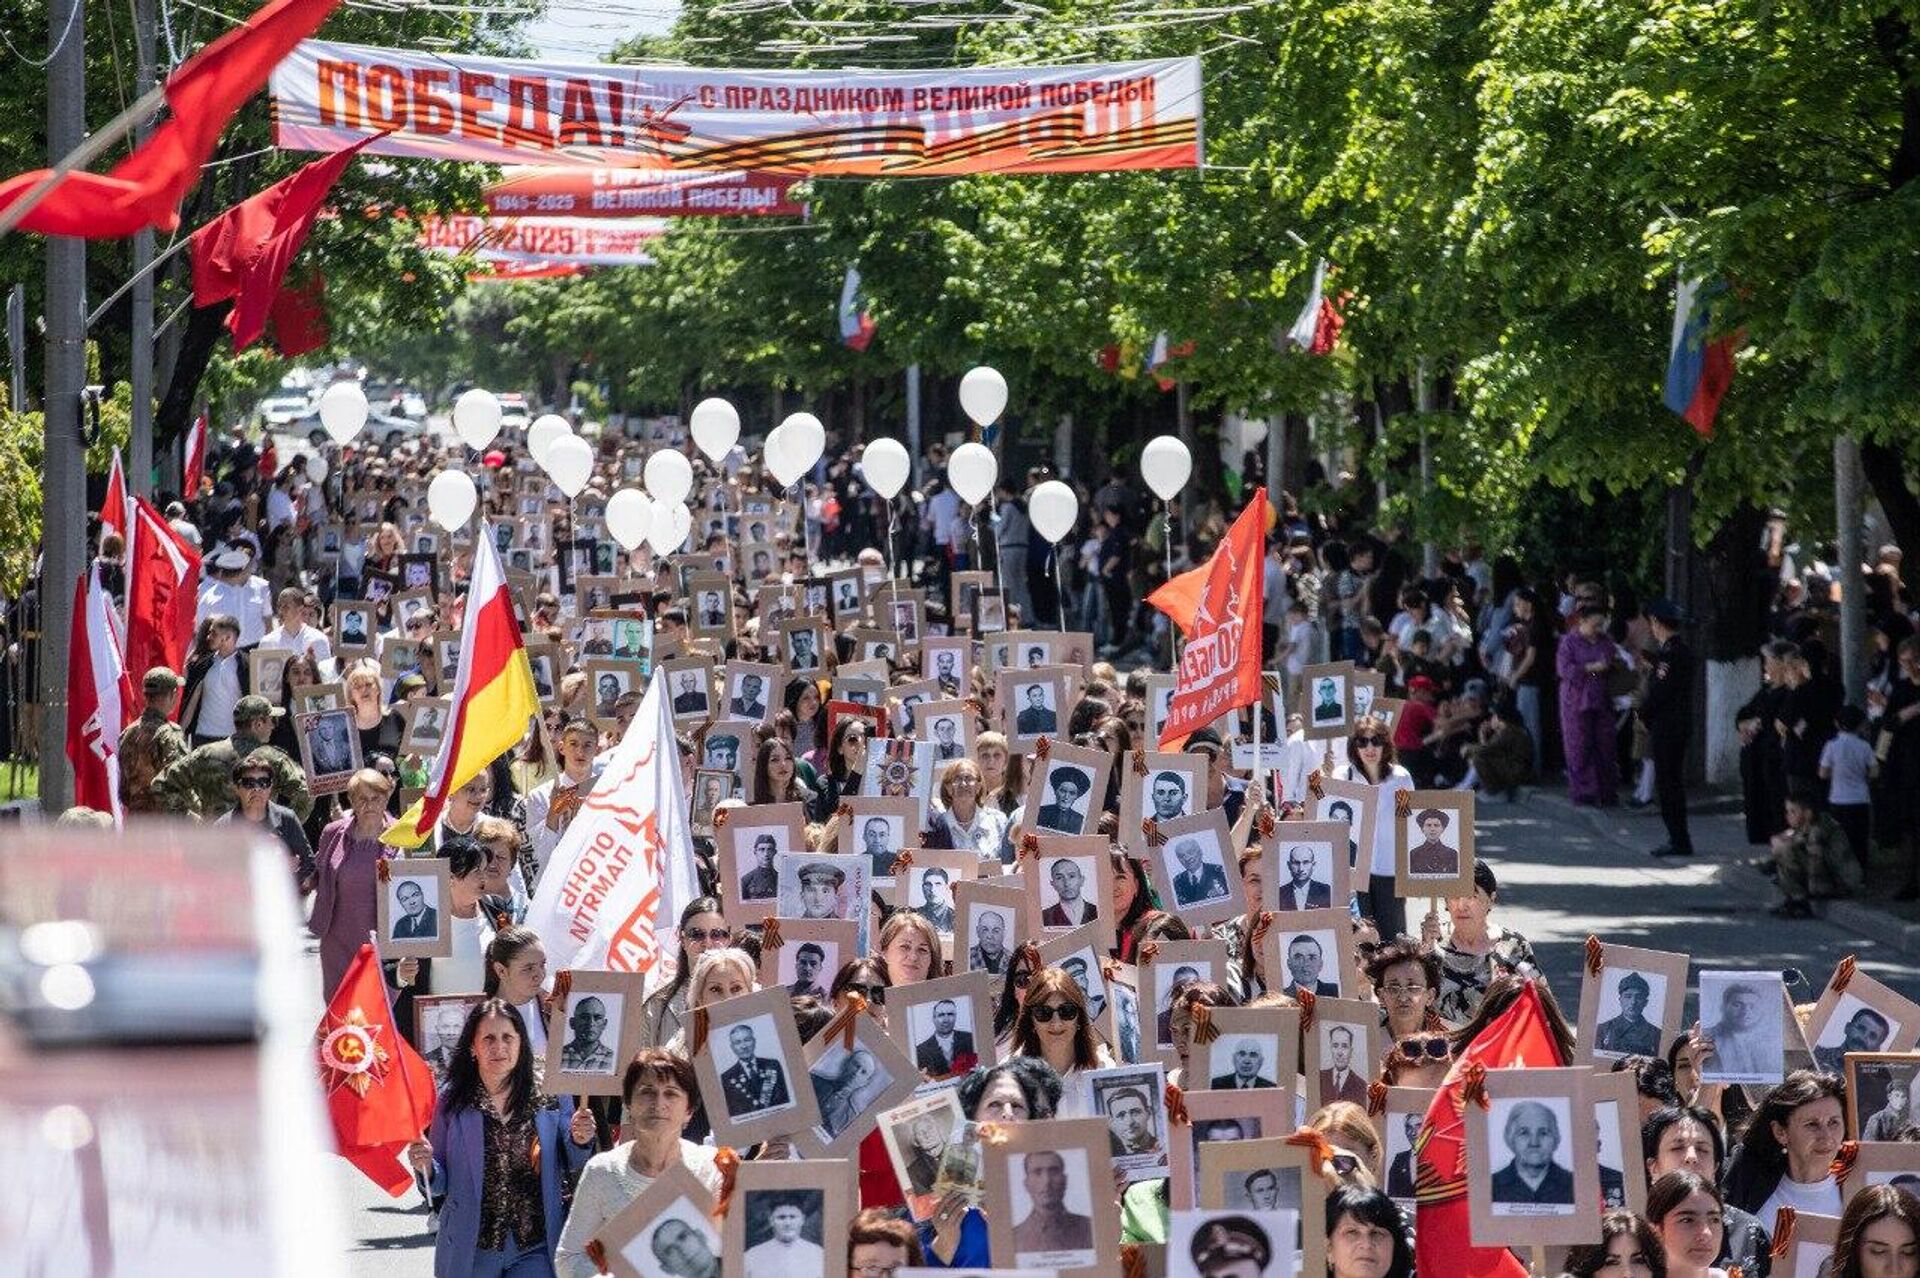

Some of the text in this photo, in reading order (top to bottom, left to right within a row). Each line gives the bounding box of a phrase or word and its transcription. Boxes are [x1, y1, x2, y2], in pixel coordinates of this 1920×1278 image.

[316, 58, 626, 150] ПОБЕДА!
[700, 76, 1156, 115] С ПРАЗДНИКОМ ВЕЛИКОЙ ПОБЕДЫ!
